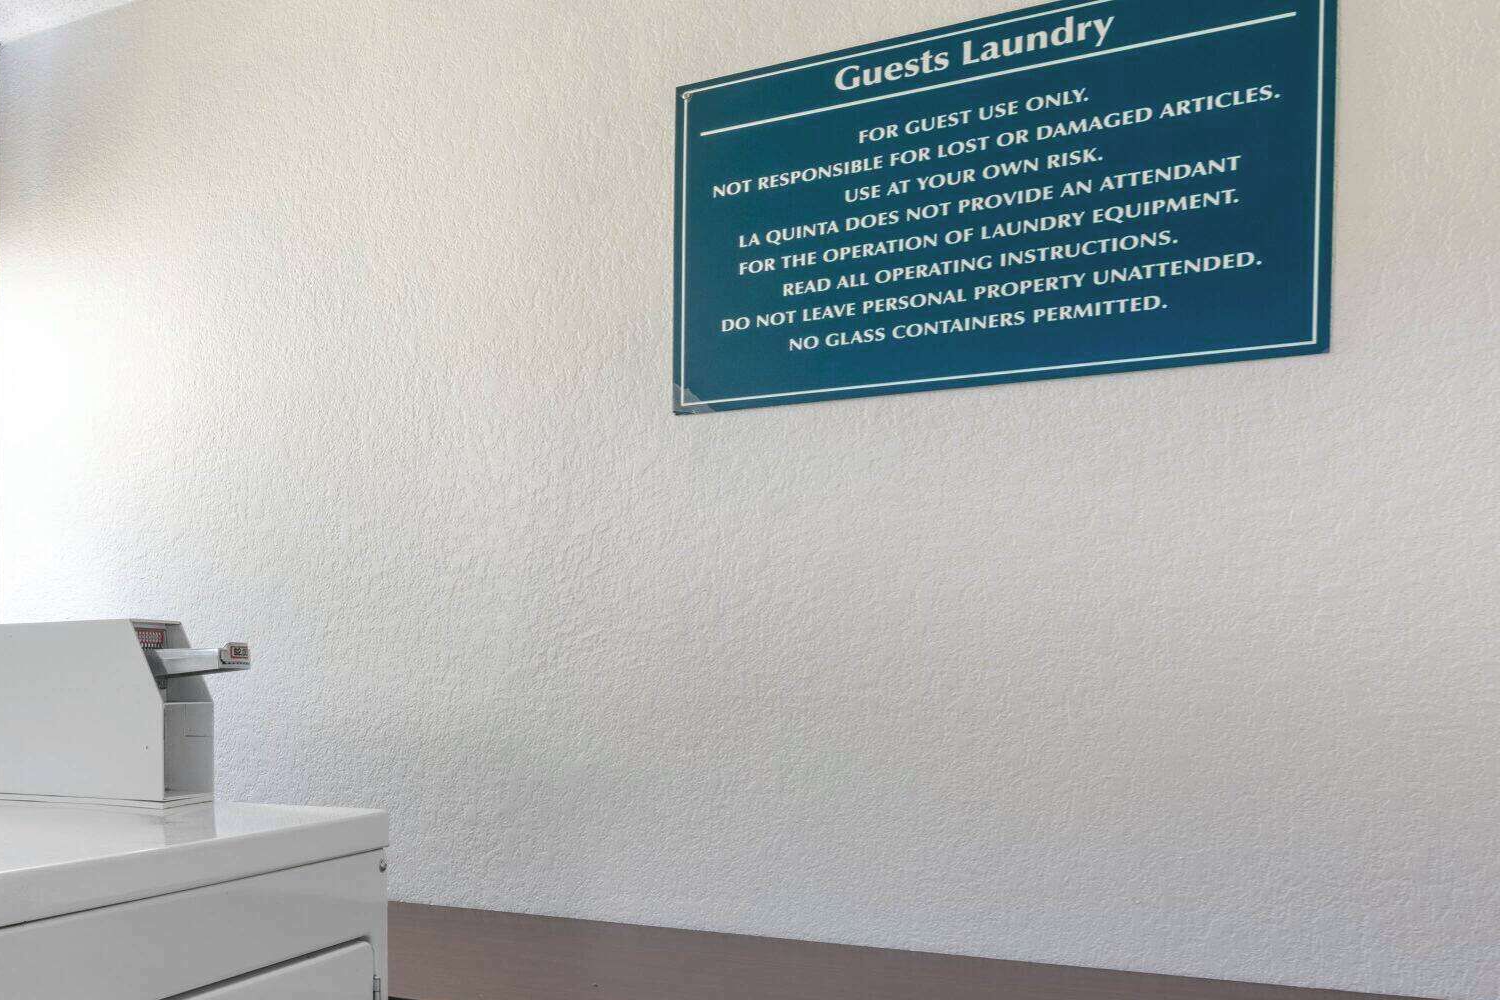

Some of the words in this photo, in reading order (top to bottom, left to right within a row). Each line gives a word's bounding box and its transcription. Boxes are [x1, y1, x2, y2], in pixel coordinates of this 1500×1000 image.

[835, 50, 949, 90] Guests
[963, 16, 1116, 65] Laundry
[714, 180, 752, 198] NOT
[759, 156, 882, 190] RESPONSIBLE
[891, 148, 930, 166] FOR
[938, 136, 989, 158] LOST
[997, 130, 1028, 146] OR
[1037, 108, 1152, 140] DAMAGED
[1159, 85, 1280, 118] ARTICLES.
[859, 125, 898, 143] FOR
[905, 110, 972, 134] GUEST
[980, 101, 1018, 120] USE
[1026, 88, 1088, 111] ONLY.
[740, 234, 760, 247] LA
[766, 221, 839, 244] QUINTA
[846, 211, 899, 231] DOES
[907, 202, 951, 221] NOT
[959, 186, 1053, 213] PROVIDE
[1060, 180, 1091, 197] AN
[1100, 156, 1241, 191] ATTENDANT
[845, 185, 880, 202] USE
[887, 180, 910, 195] AT
[917, 169, 975, 190] YOUR
[983, 158, 1038, 179] OWN
[1048, 148, 1102, 169] RISK.
[740, 258, 775, 275] FOR
[781, 252, 816, 268] THE
[823, 234, 937, 262] OPERATION
[945, 228, 973, 244] OF
[982, 212, 1085, 239] LAUNDRY
[1093, 189, 1238, 223] EQUIPMENT.
[783, 278, 830, 296] READ
[837, 273, 868, 289] ALL
[875, 256, 992, 283] OPERATING
[1001, 231, 1178, 266] INSTRUCTIONS.
[722, 317, 750, 332] DO
[757, 310, 796, 327] NOT
[803, 303, 855, 321] LEAVE
[863, 289, 966, 314] PERSONAL
[975, 273, 1085, 300] PROPERTY
[1094, 252, 1262, 285] UNATTENDED.
[790, 336, 819, 350] NO
[826, 328, 885, 346] GLASS
[892, 311, 1025, 338] CONTAINERS
[1034, 296, 1167, 323] PERMITTED.
